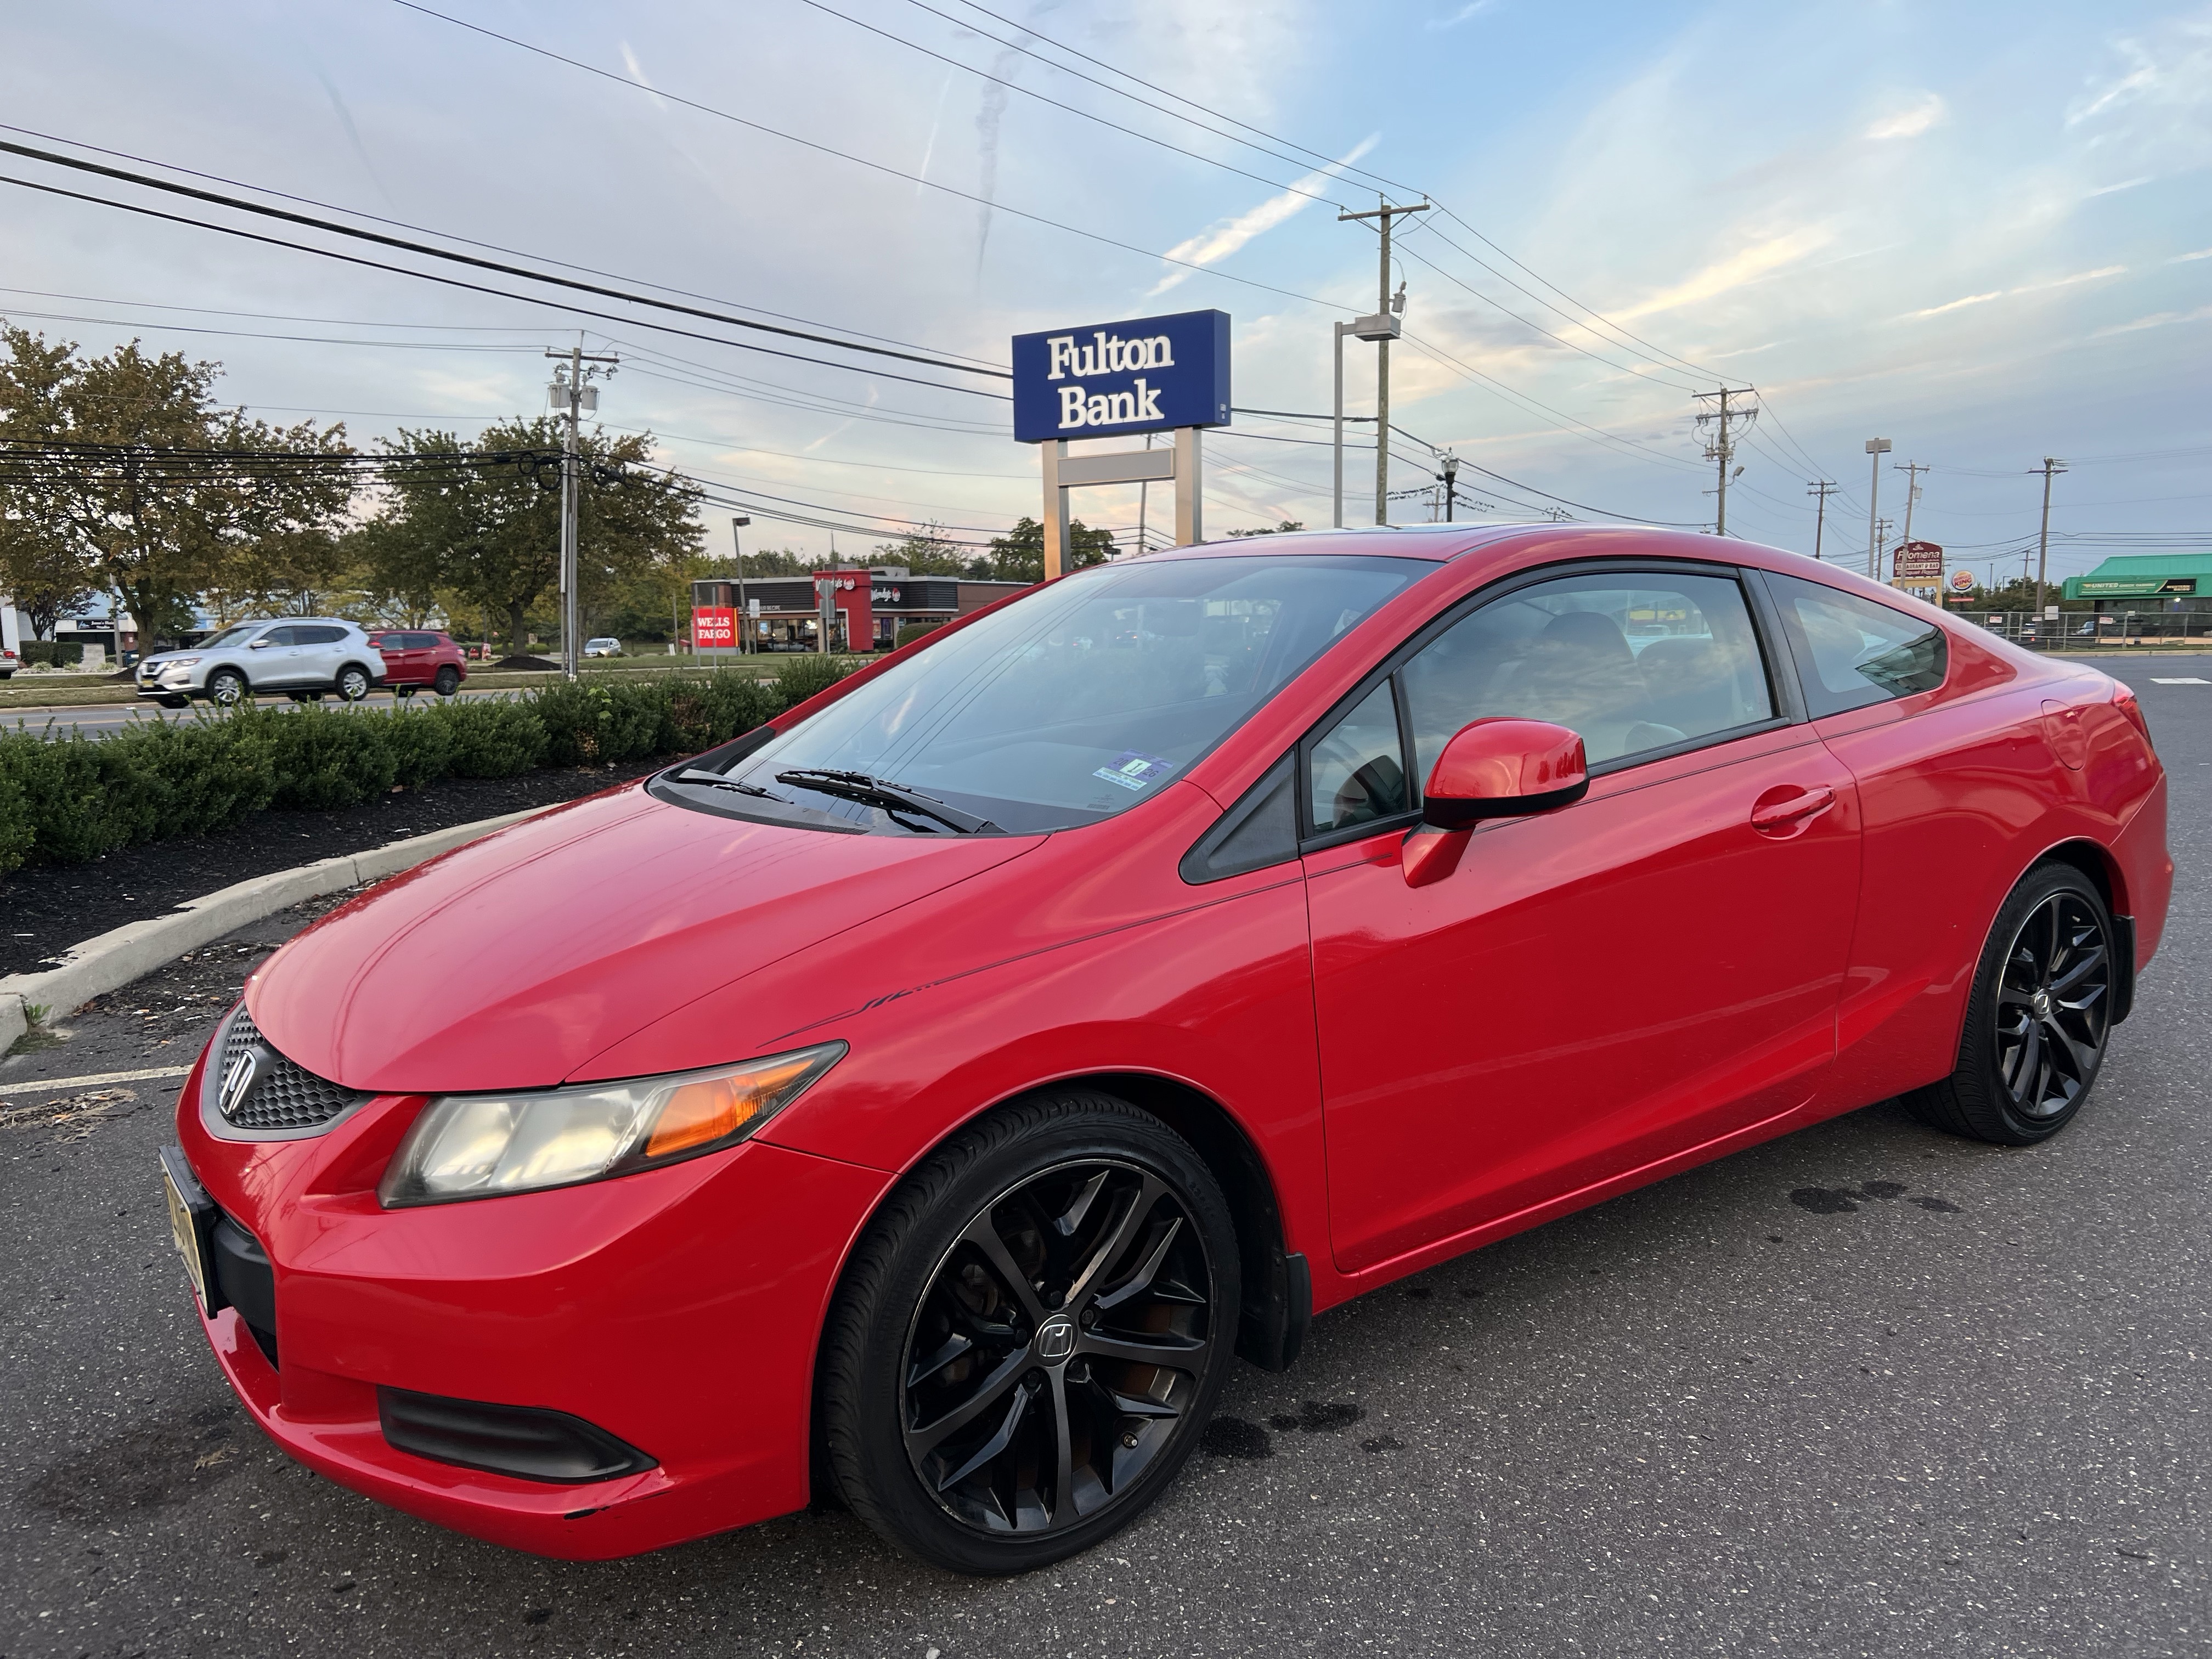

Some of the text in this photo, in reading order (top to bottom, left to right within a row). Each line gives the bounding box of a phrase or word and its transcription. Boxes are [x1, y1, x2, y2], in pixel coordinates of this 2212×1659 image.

[1047, 331, 1175, 380] Fulton
[1058, 377, 1165, 429] Bank
[1898, 551, 1940, 560] Fomena
[1955, 578, 1972, 586] KING
[1113, 758, 1129, 766] 20
[1127, 763, 1143, 773] 1
[1142, 768, 1159, 777] 26
